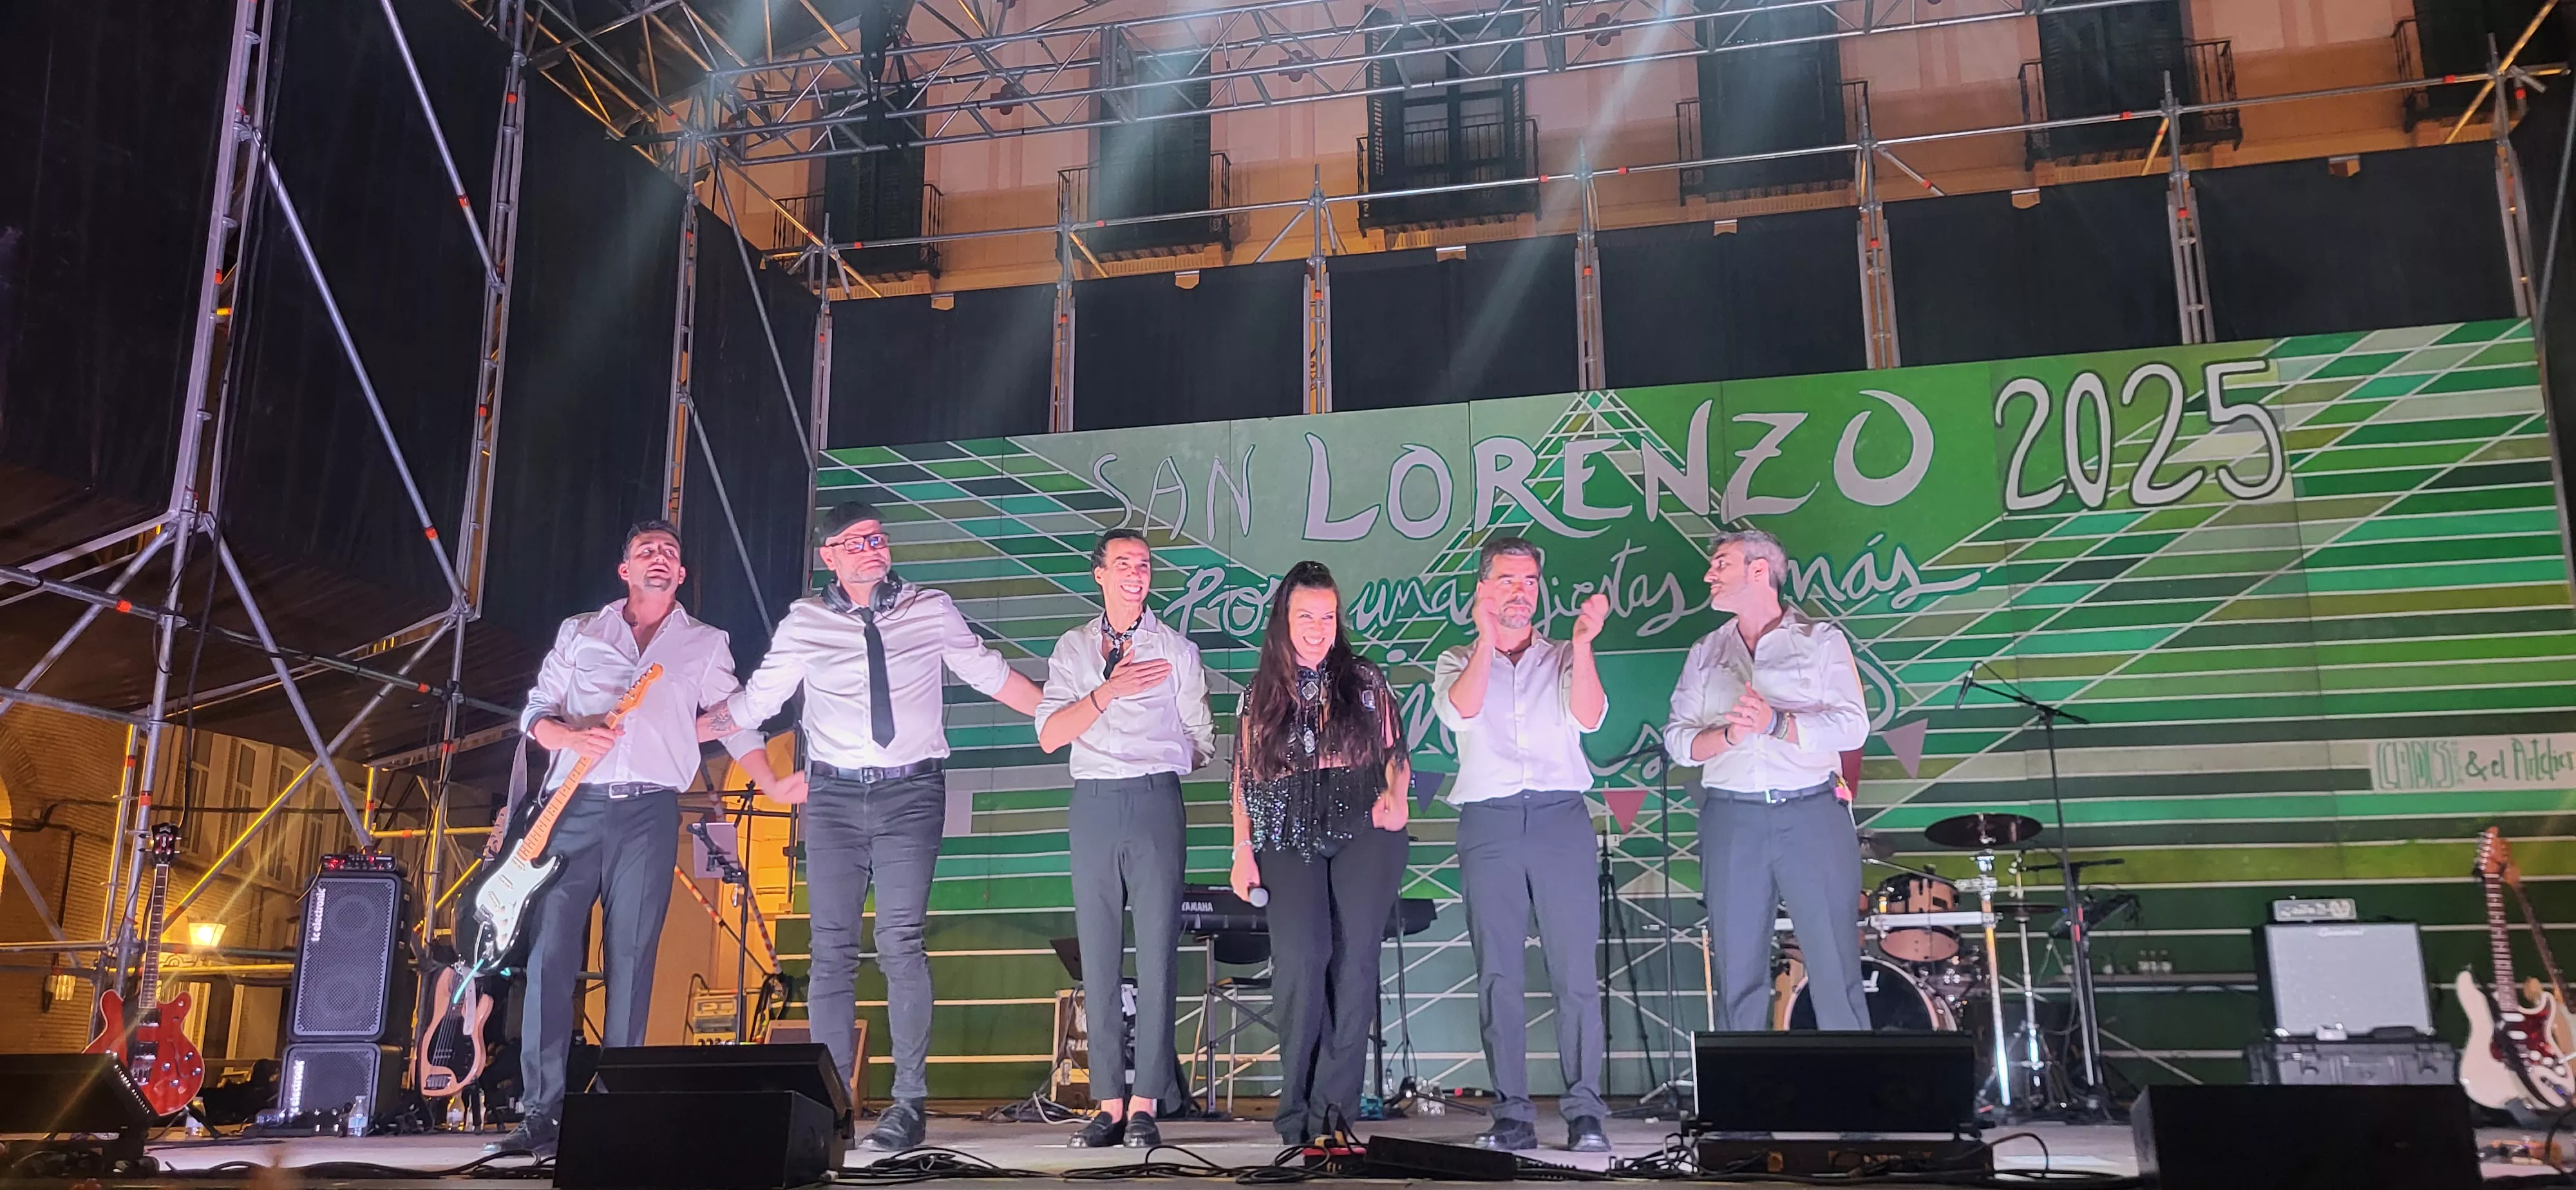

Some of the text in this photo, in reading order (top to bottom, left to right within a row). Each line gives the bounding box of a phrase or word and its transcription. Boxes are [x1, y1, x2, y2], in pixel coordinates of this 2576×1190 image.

[1093, 356, 2286, 542] SAN LORENZO 2025
[1349, 579, 1478, 631] una
[312, 887, 327, 932] electronic
[1181, 901, 1214, 912] YAMAHA
